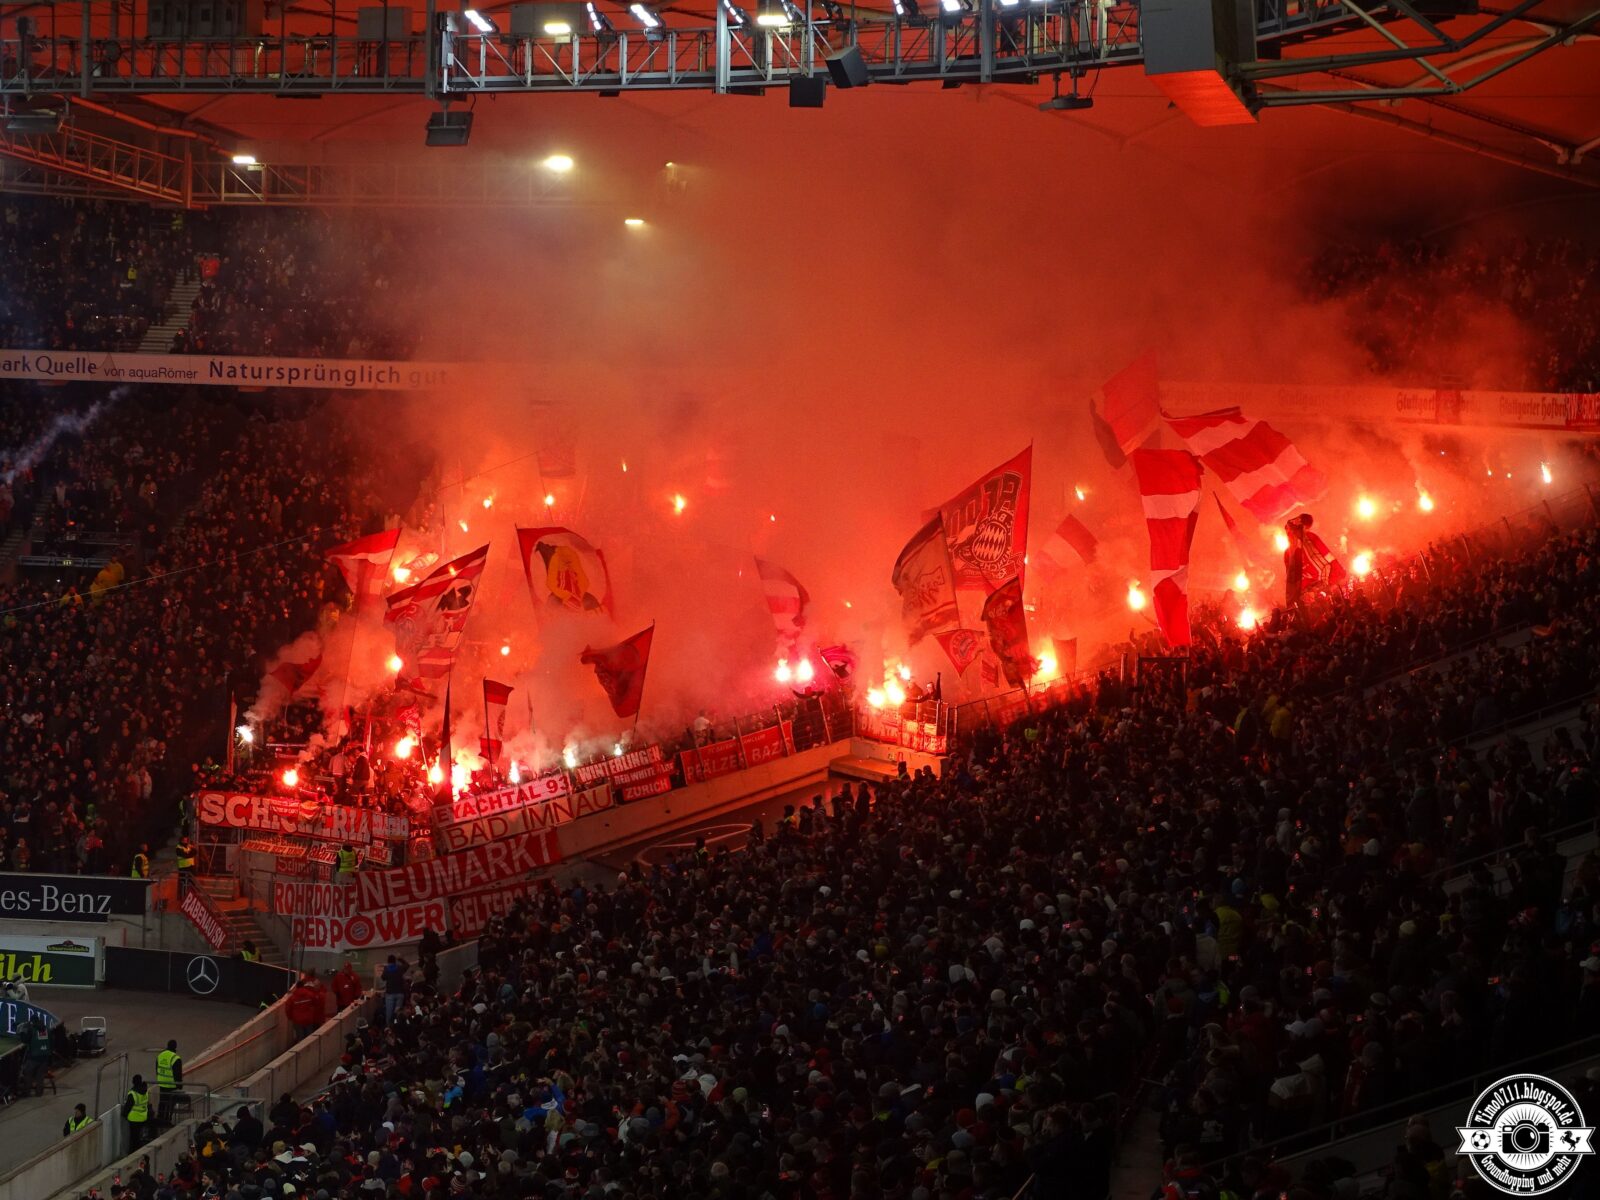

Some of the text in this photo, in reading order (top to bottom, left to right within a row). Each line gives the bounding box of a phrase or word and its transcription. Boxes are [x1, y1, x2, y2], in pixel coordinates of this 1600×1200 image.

[36, 355, 97, 377] Quelle
[103, 368, 126, 378] von
[128, 366, 199, 382] aquaRömer
[208, 358, 400, 386] Natursprünglich
[577, 745, 661, 783] WINTERLINGEN
[437, 784, 541, 821] EYACHTAL
[450, 815, 508, 847] BAD
[523, 784, 613, 829] IMNAU
[361, 831, 553, 907] NEUMARKT
[275, 883, 356, 917] ROHRDORF
[331, 903, 446, 946] POWER
